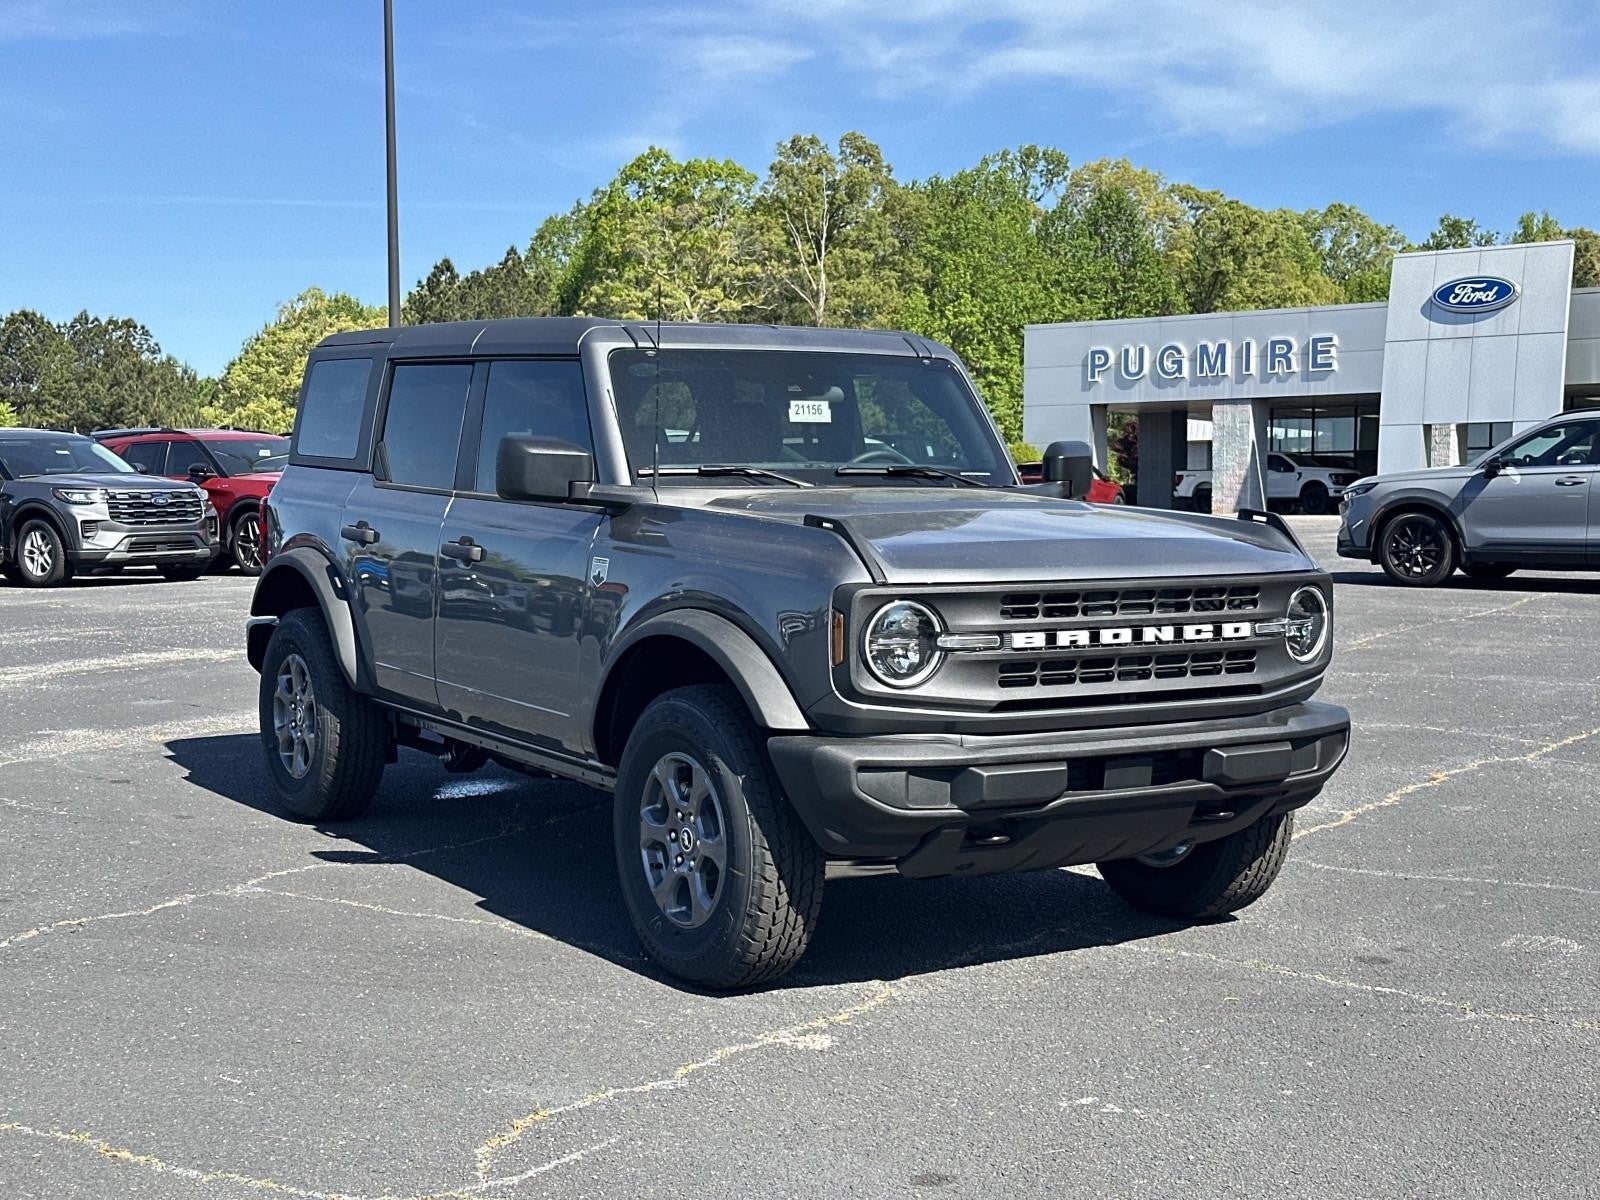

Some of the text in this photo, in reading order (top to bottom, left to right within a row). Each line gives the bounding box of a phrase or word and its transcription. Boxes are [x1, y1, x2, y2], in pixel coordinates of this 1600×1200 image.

[1449, 283, 1499, 304] Ford
[1087, 335, 1338, 382] PUGMIRE
[794, 404, 823, 415] 21156
[1011, 622, 1251, 649] BRONCO
